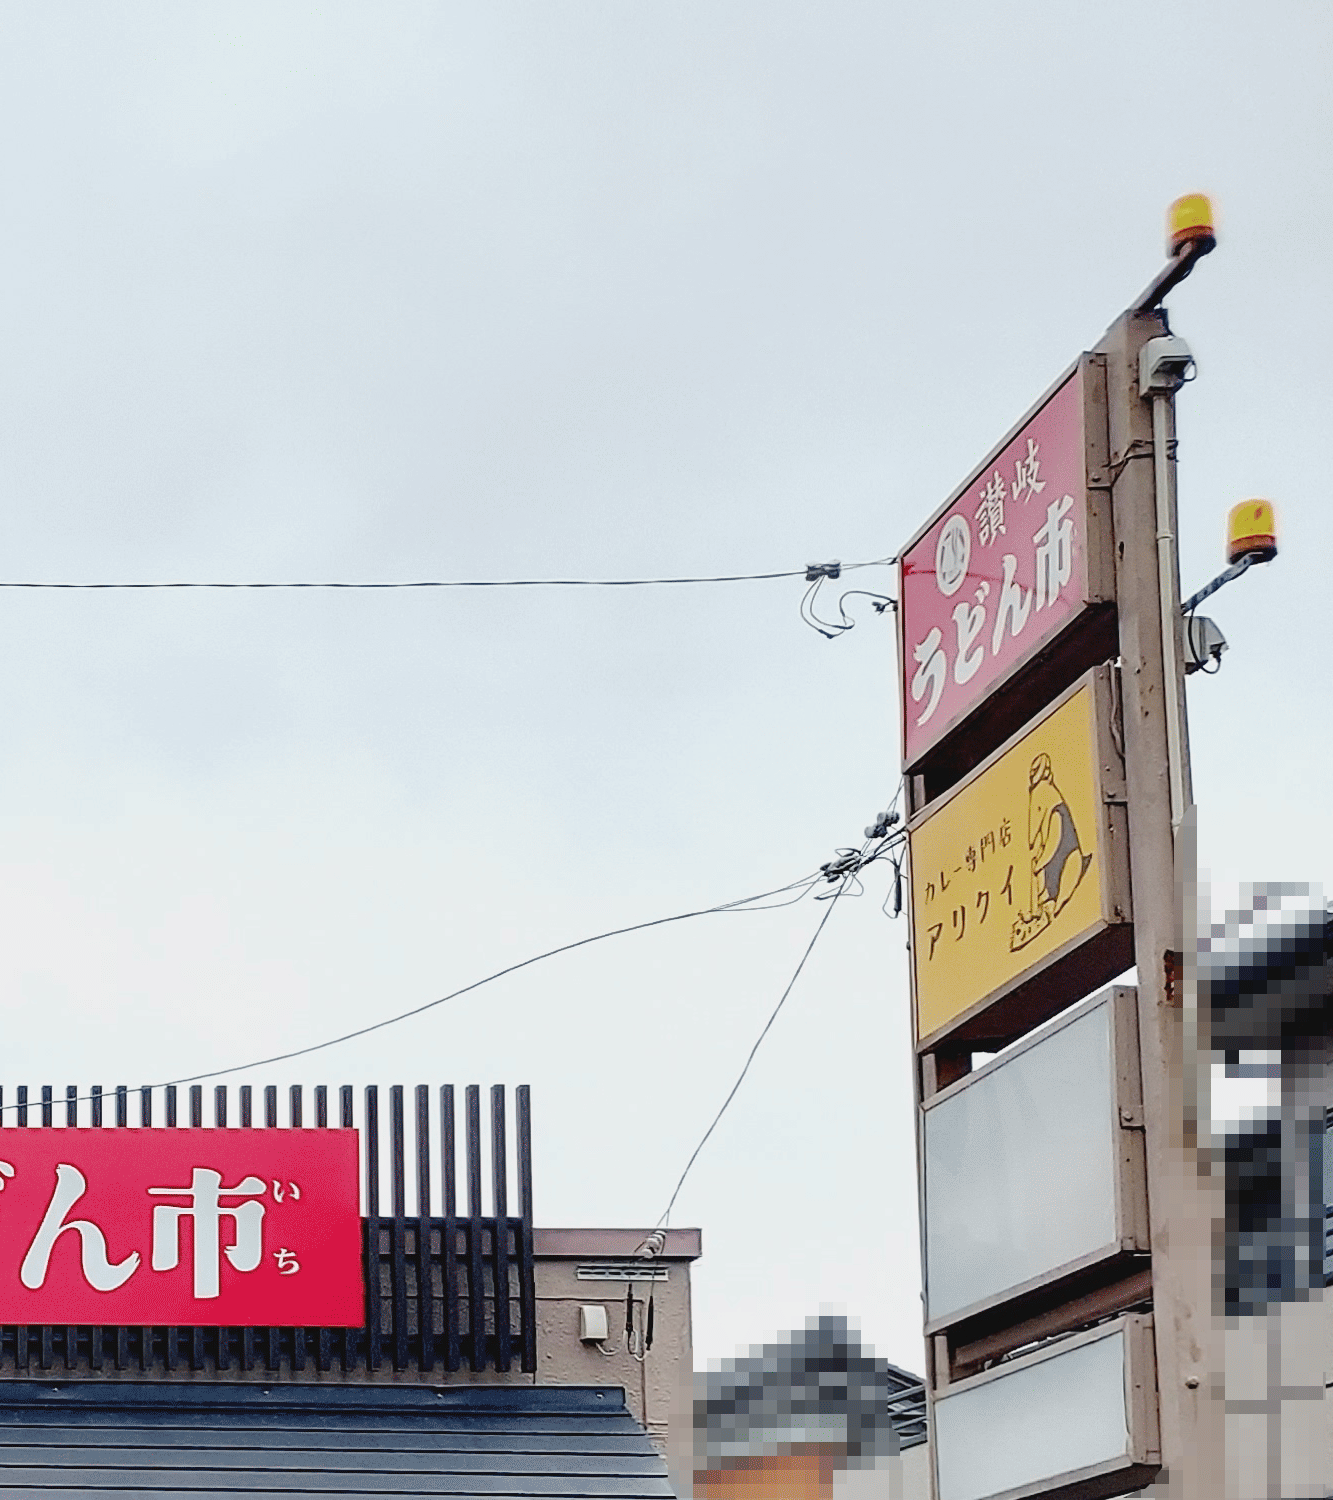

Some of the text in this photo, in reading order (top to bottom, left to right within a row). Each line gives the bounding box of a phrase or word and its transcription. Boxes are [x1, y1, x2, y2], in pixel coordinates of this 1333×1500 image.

[912, 495, 1074, 727] うどん市
[925, 817, 1011, 905] カレー専門店
[926, 864, 1014, 961] アリクイ
